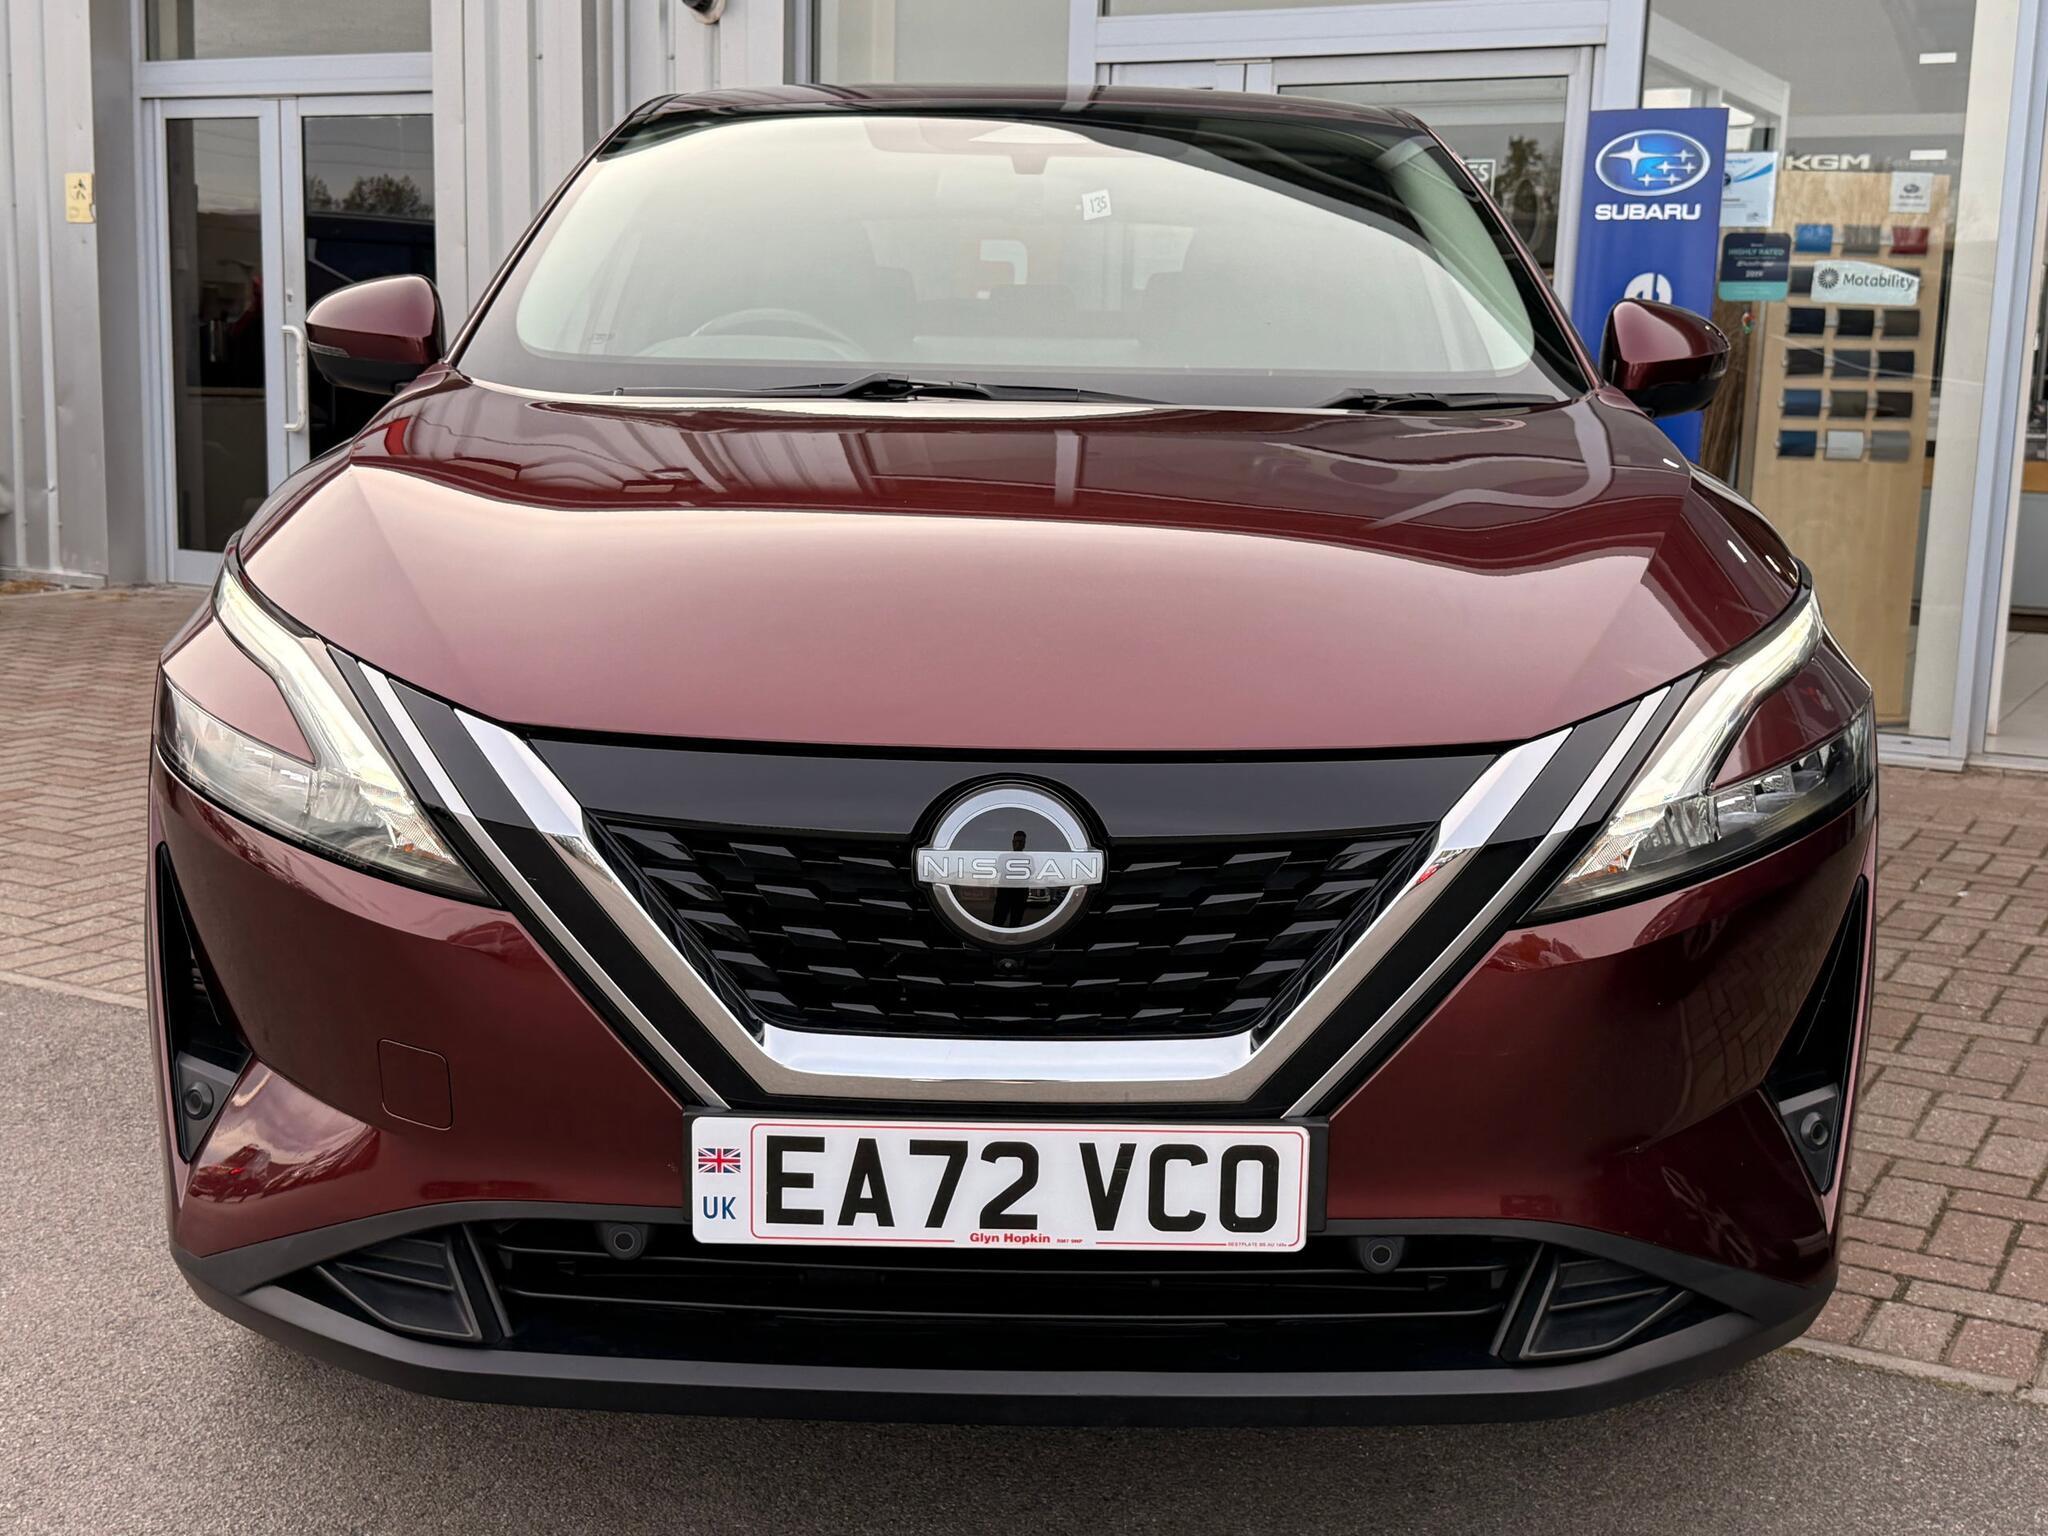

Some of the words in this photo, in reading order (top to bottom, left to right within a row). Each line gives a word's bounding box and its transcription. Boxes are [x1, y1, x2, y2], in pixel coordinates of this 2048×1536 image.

[1785, 153, 1871, 171] KGM
[1594, 203, 1701, 220] SUBARU
[1842, 273, 1914, 292] Motability
[922, 855, 1098, 880] NISSAN
[765, 1135, 1039, 1230] EA72
[1079, 1142, 1279, 1233] VCO
[703, 1196, 736, 1220] UK
[969, 1232, 1000, 1244] Glyn
[1003, 1232, 1051, 1245] Hopkin
